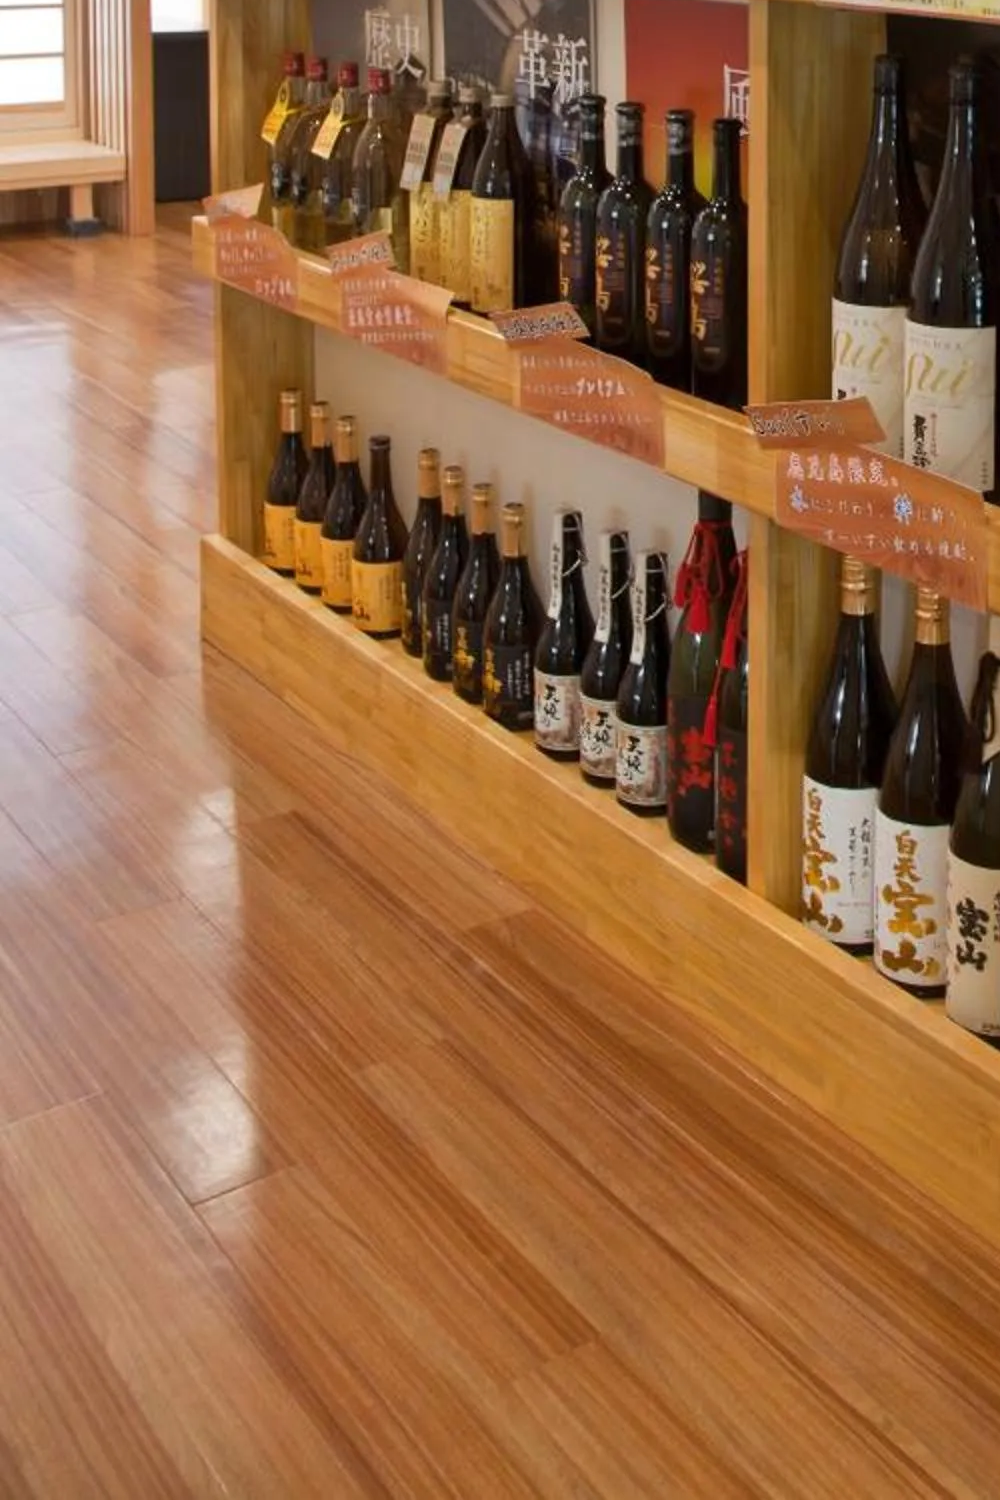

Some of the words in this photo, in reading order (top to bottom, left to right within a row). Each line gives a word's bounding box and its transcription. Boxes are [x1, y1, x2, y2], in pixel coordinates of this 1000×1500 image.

[513, 27, 592, 106] 革新
[881, 829, 941, 978] 白天宝山
